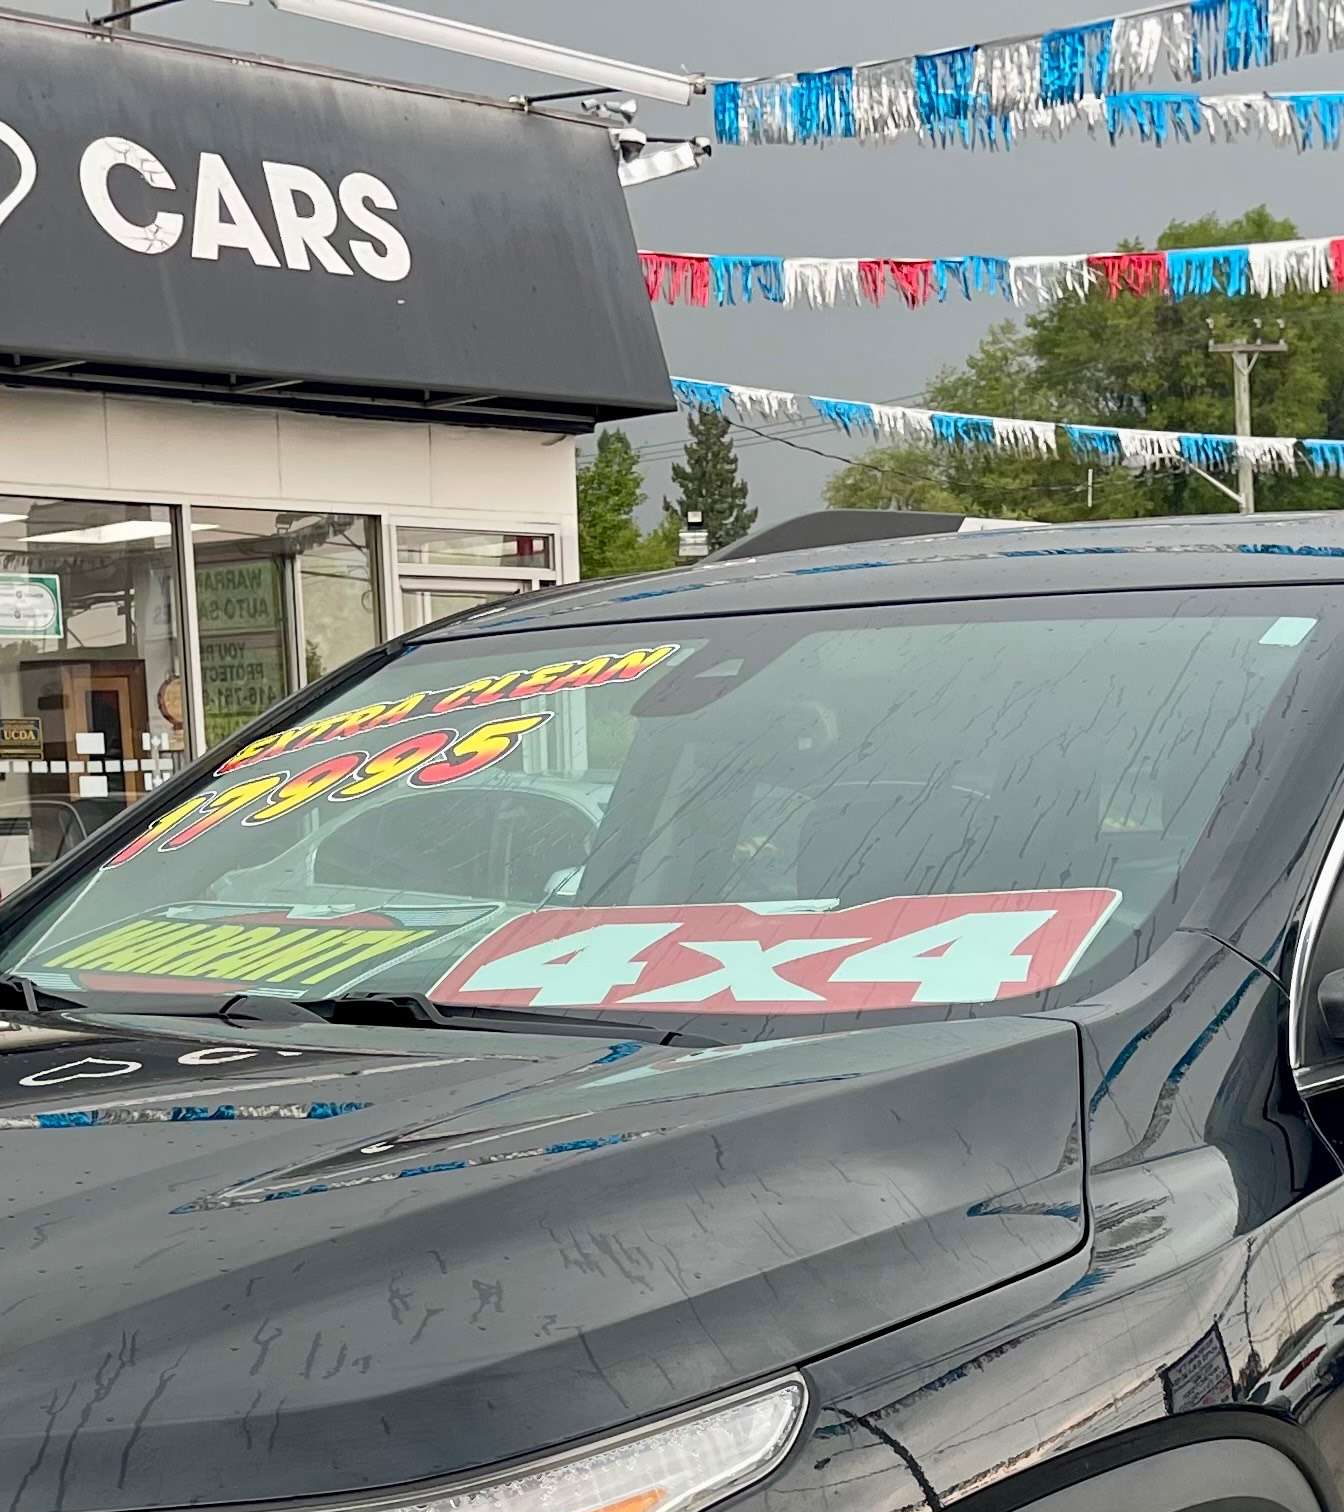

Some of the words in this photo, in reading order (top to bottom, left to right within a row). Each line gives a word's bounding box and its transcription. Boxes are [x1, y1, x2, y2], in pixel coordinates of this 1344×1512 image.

[79, 136, 413, 283] CARS
[3, 730, 36, 740] UCDA
[215, 690, 431, 776] EXTRA
[432, 643, 680, 714] CLEAN
[100, 711, 554, 871] 17995
[42, 919, 436, 984] WARRANTY
